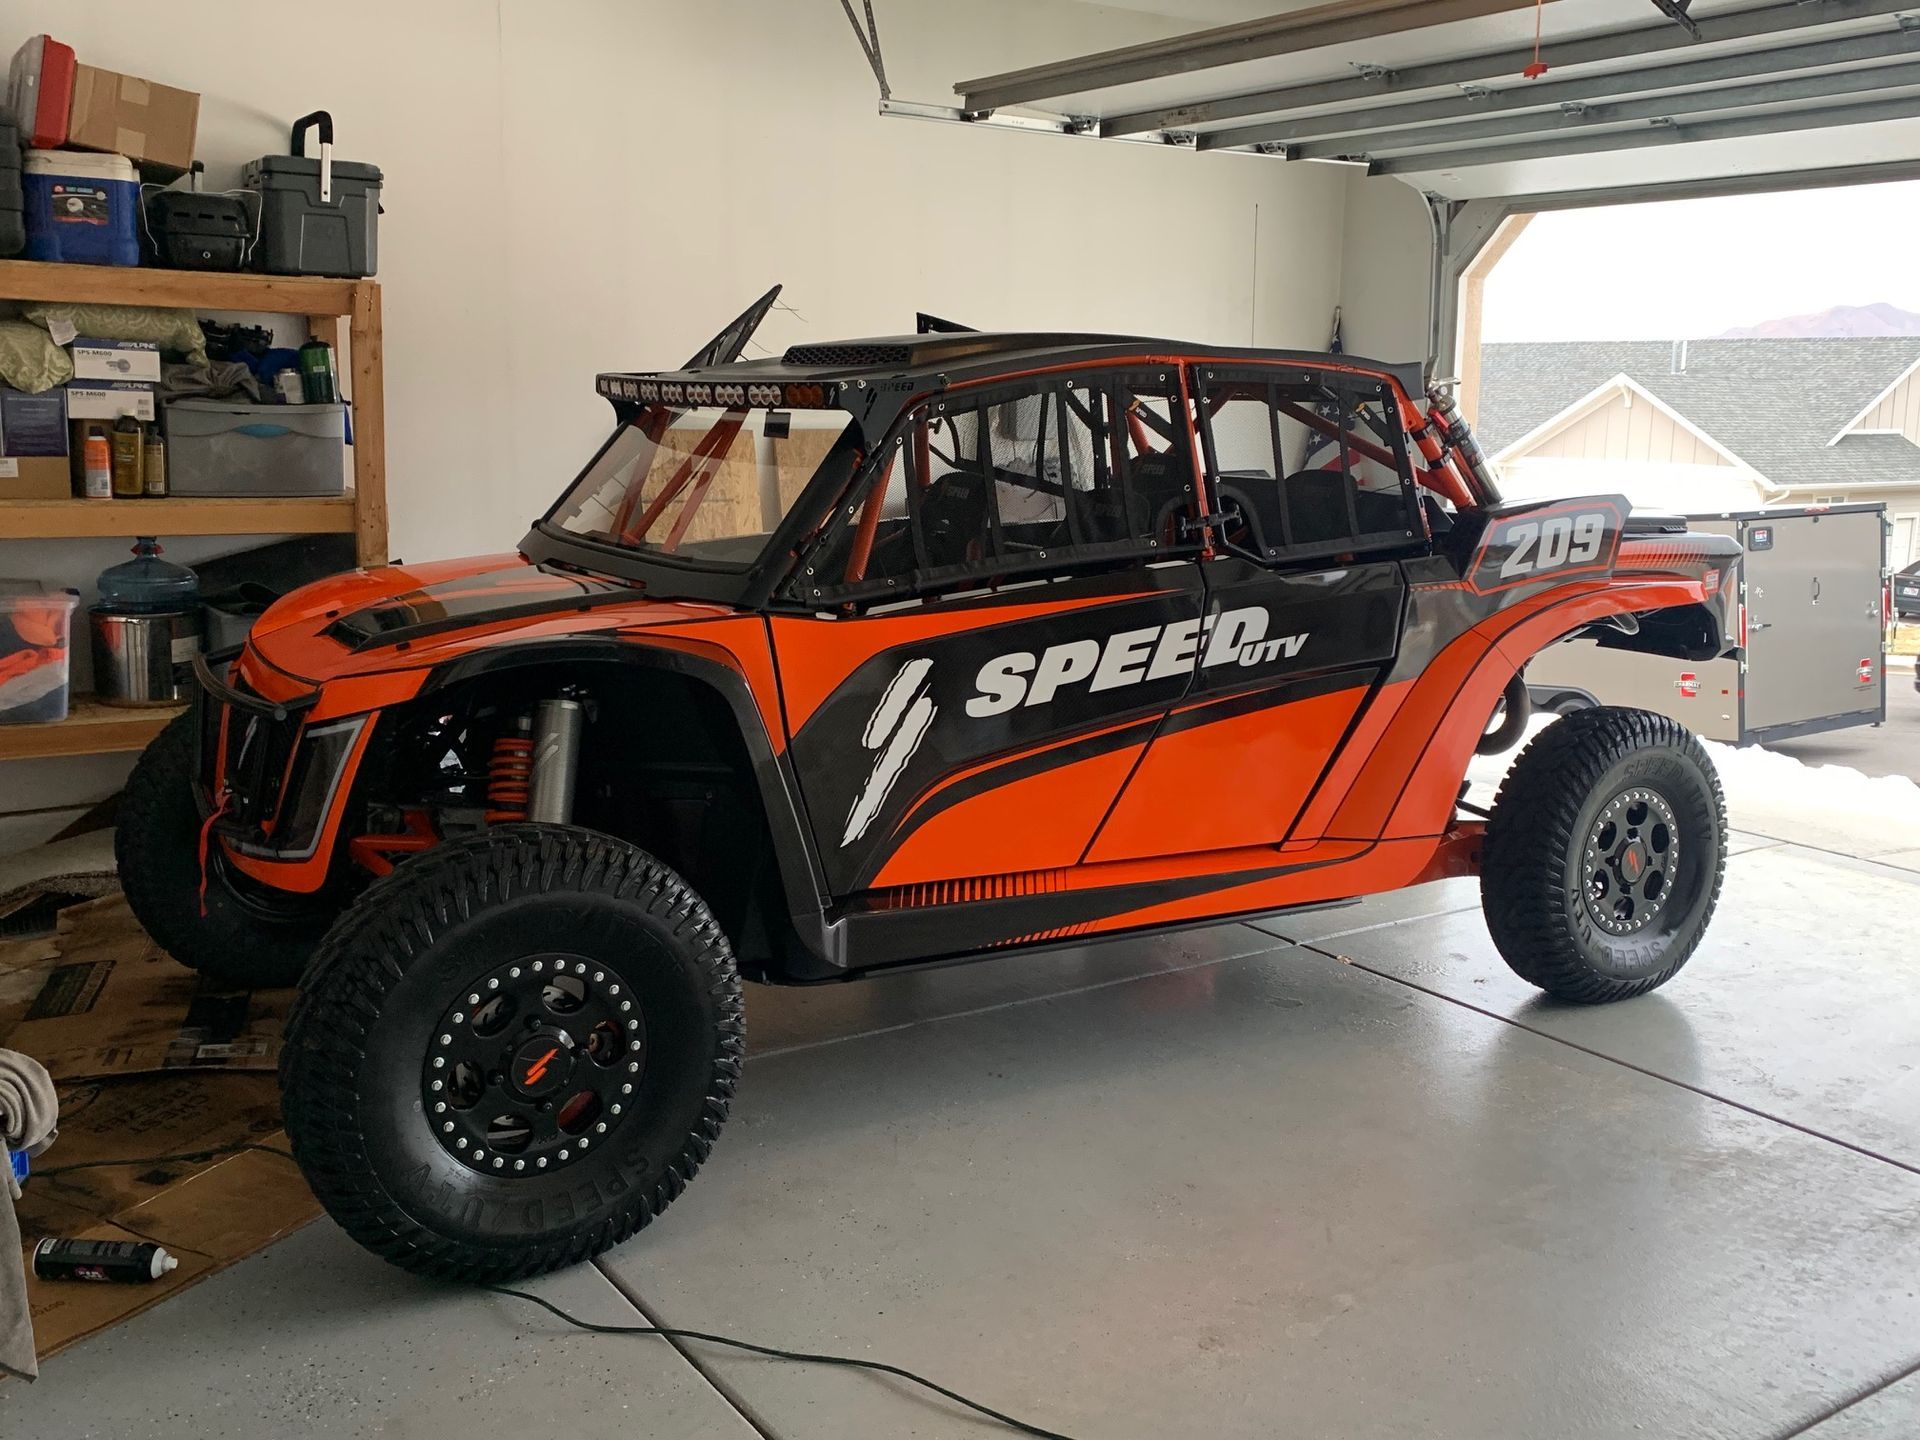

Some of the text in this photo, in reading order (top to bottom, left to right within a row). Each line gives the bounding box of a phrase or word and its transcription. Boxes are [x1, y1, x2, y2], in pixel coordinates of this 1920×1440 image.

[1500, 513, 1605, 579] 209
[965, 606, 1310, 718] SPEED UTV
